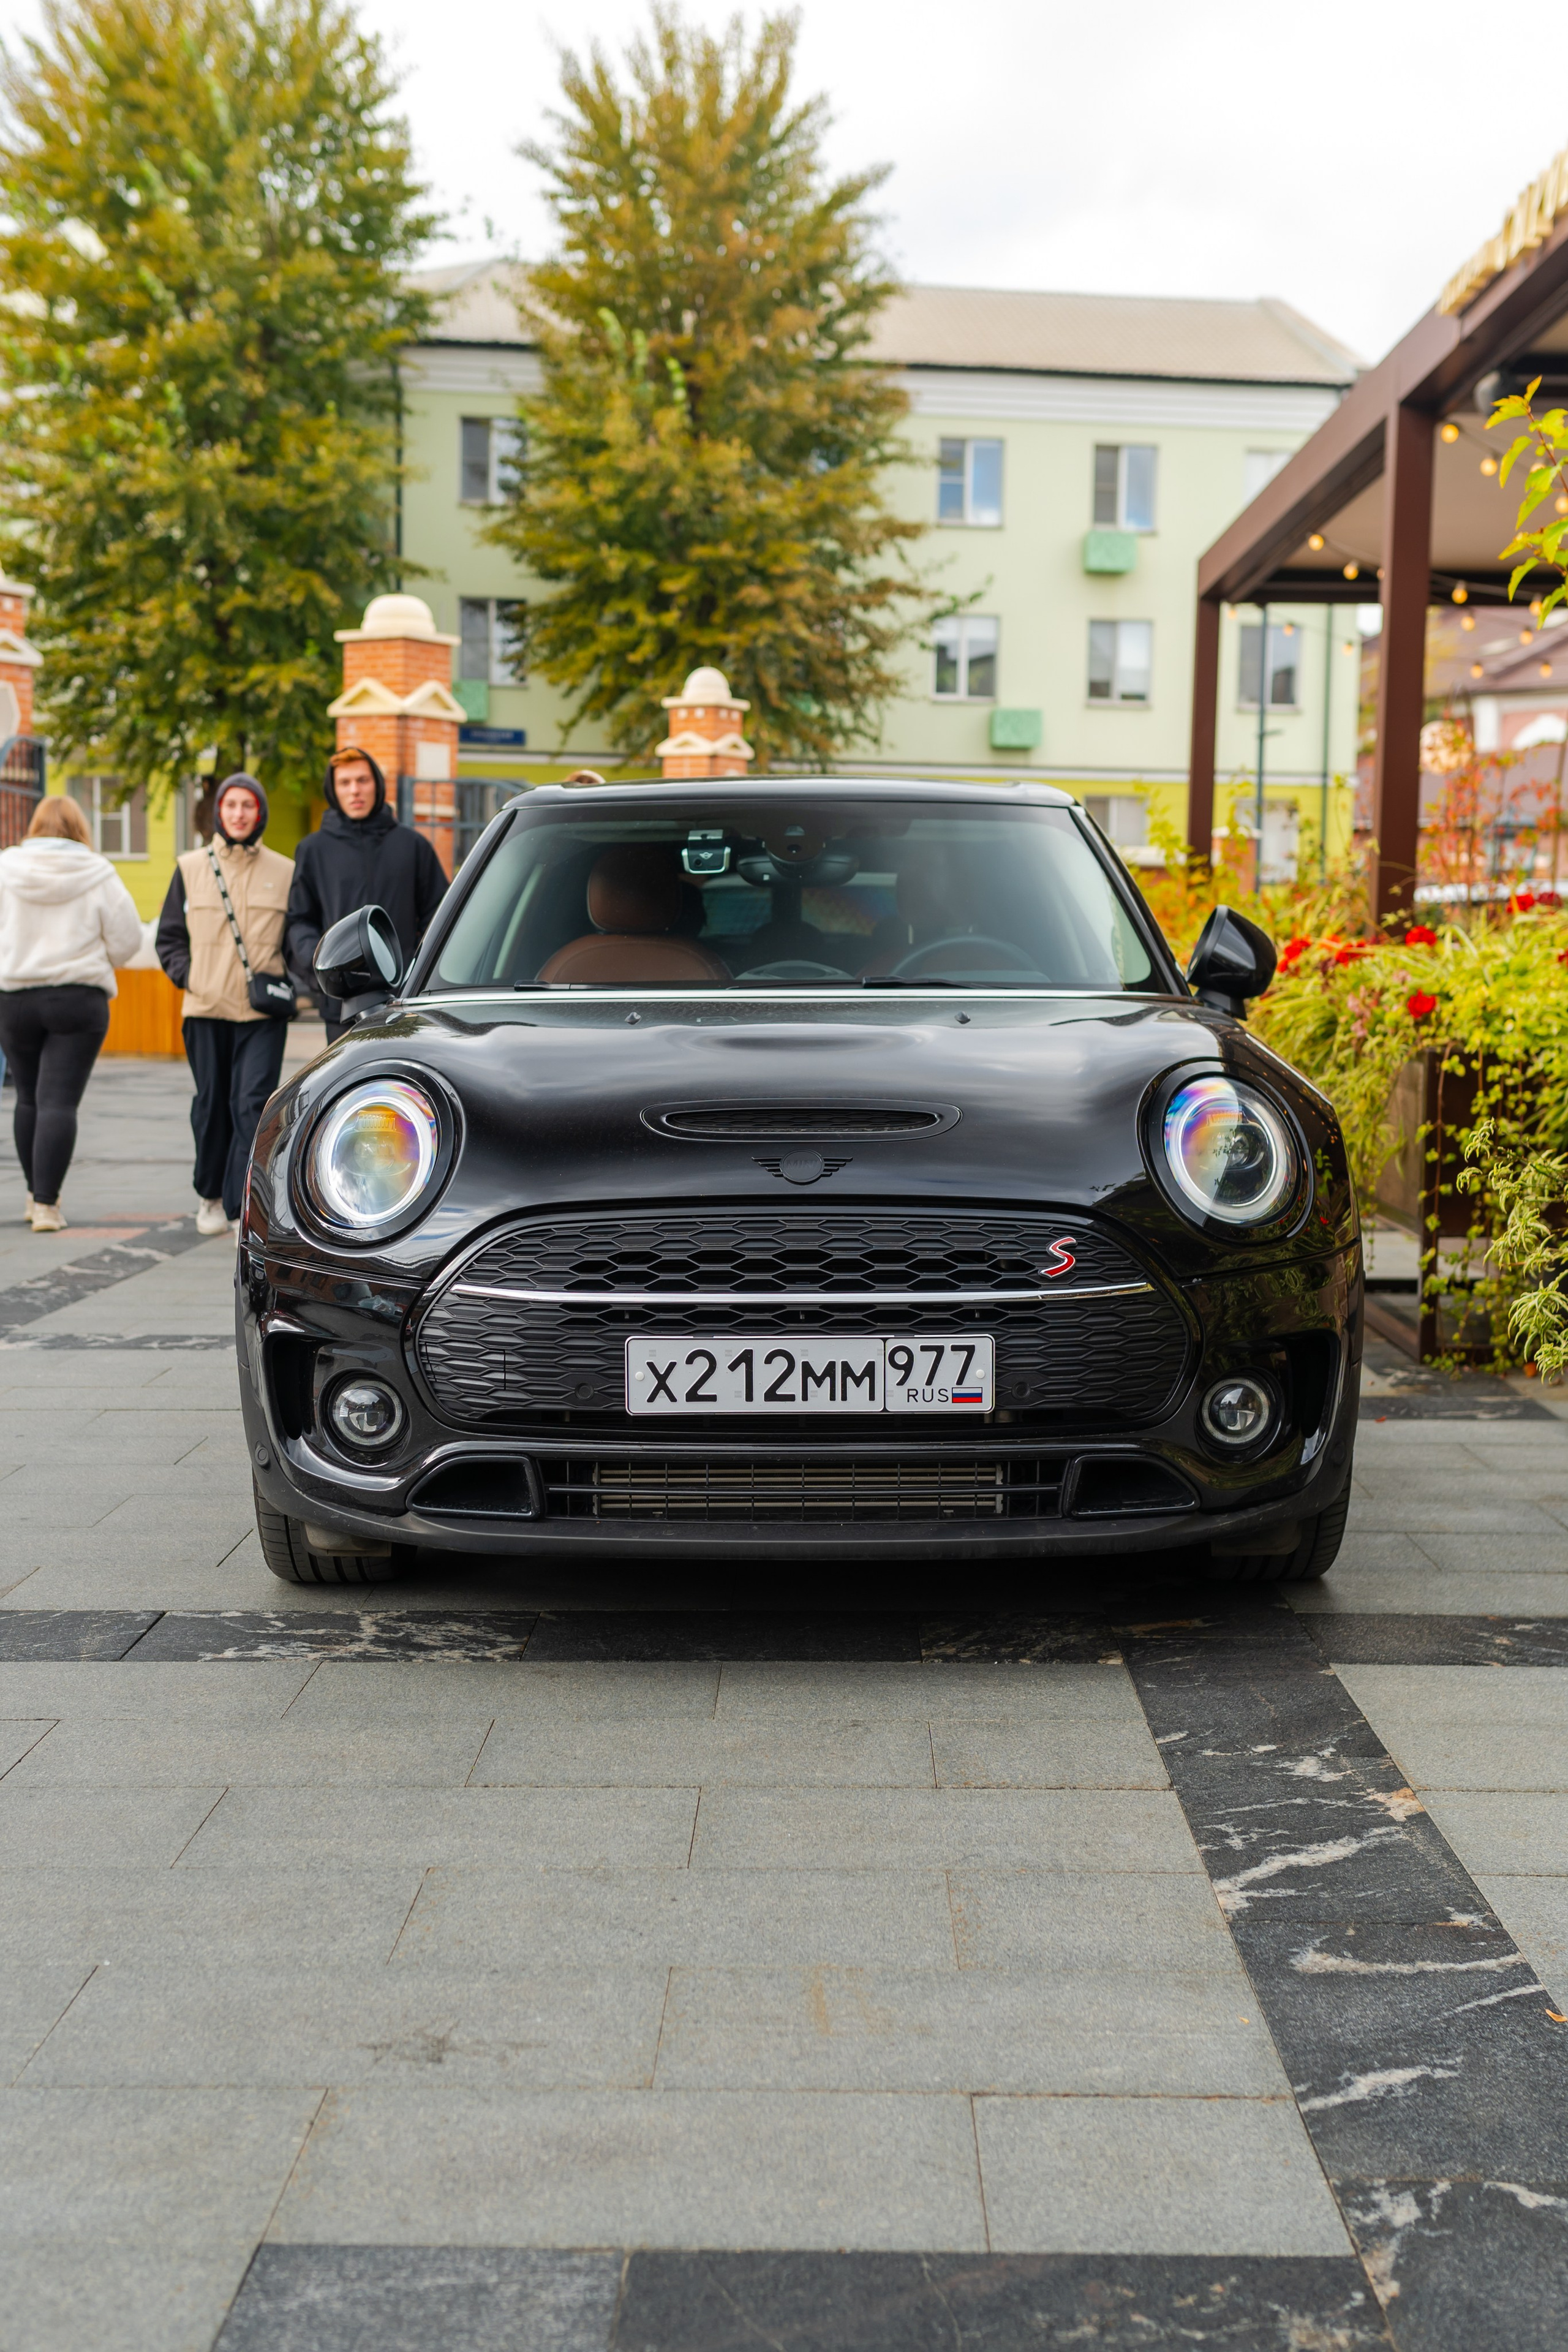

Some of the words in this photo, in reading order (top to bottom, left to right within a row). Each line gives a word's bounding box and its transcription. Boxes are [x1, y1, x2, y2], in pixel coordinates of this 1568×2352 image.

[1040, 1237, 1077, 1279] S
[887, 1344, 976, 1386] 977
[907, 1388, 949, 1403] RUS
